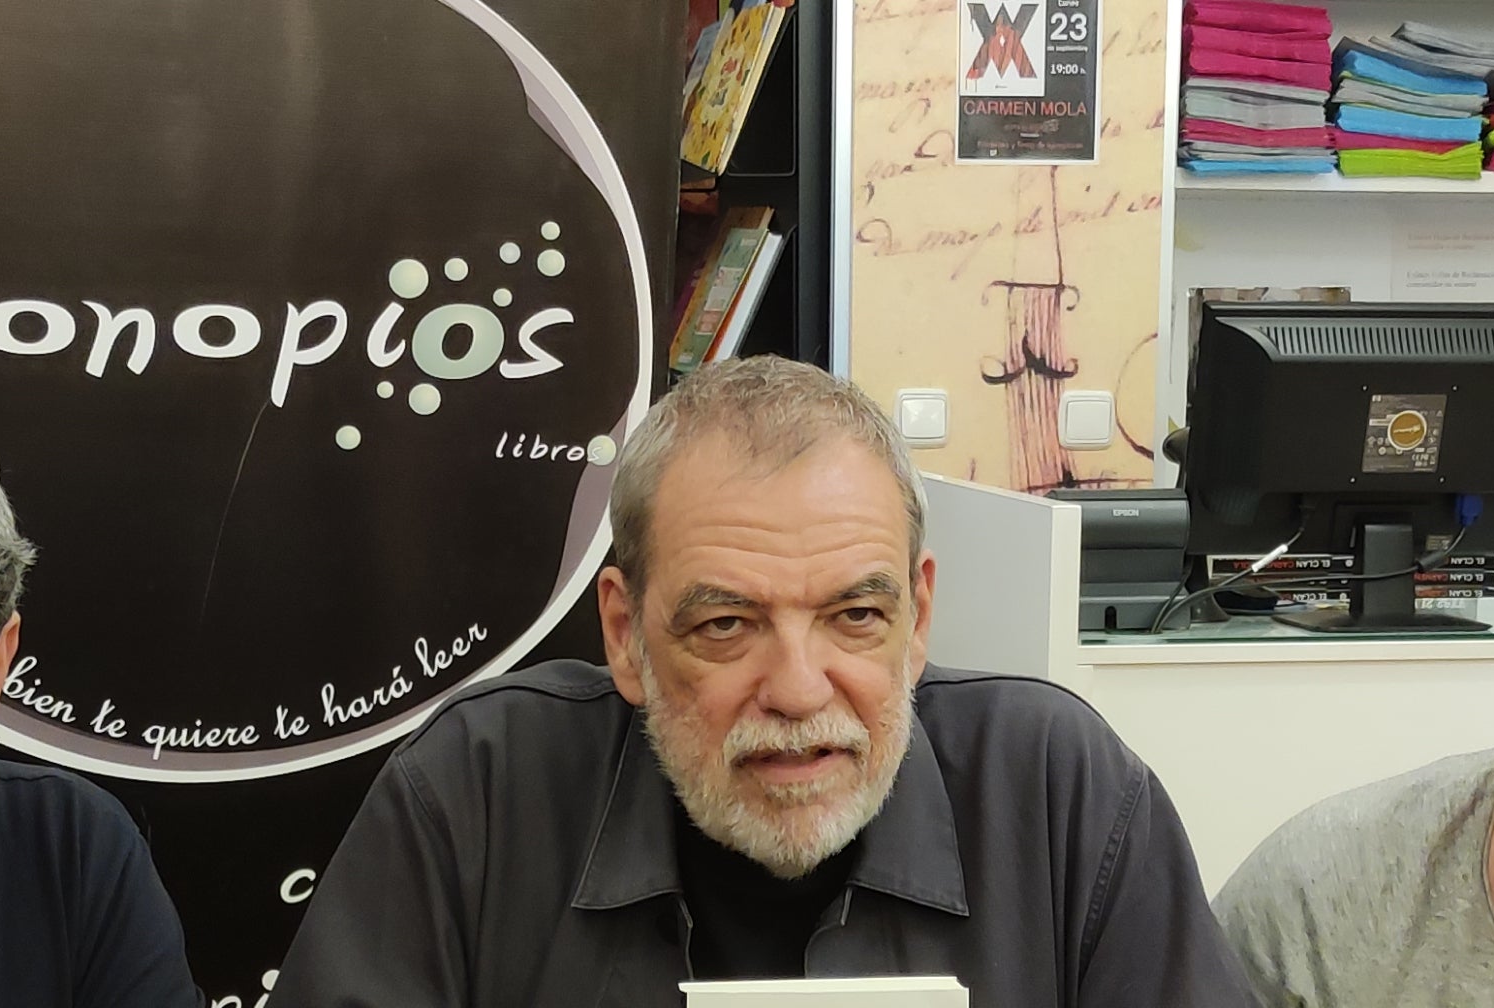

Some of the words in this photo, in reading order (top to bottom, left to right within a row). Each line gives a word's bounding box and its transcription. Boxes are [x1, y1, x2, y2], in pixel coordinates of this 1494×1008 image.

[1050, 12, 1087, 41] 23
[1050, 64, 1079, 75] 19:00
[963, 101, 1036, 115] CARMEN
[1040, 101, 1087, 116] MOLA
[494, 430, 604, 462] libros
[1112, 508, 1140, 517] EPSON
[2, 655, 77, 724] bien
[89, 697, 128, 740] te
[141, 718, 261, 761] quiere
[273, 704, 311, 741] te
[320, 665, 415, 728] hará
[414, 622, 489, 678] leer
